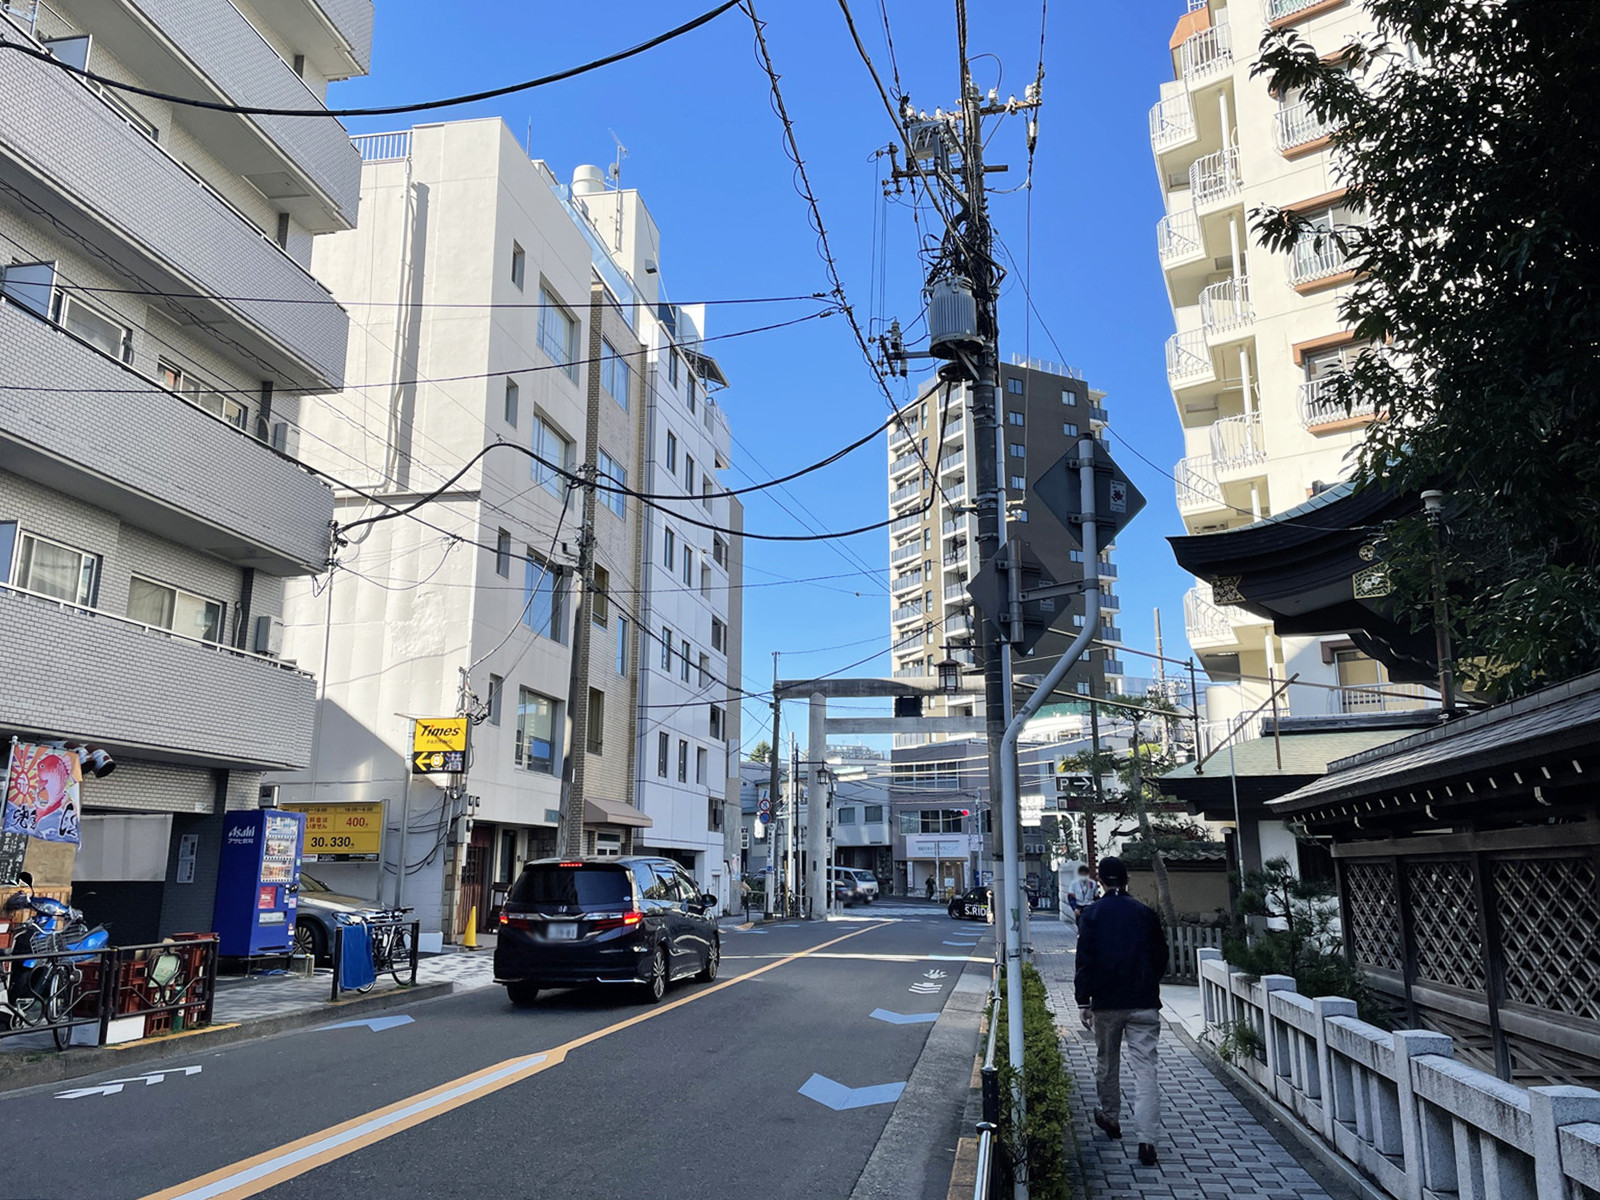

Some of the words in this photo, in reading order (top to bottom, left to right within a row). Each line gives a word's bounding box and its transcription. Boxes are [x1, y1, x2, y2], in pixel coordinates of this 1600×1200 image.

[421, 725, 461, 737] Times
[1060, 778, 1069, 791] P
[228, 826, 256, 838] Asahi
[964, 907, 989, 917] S.RID
